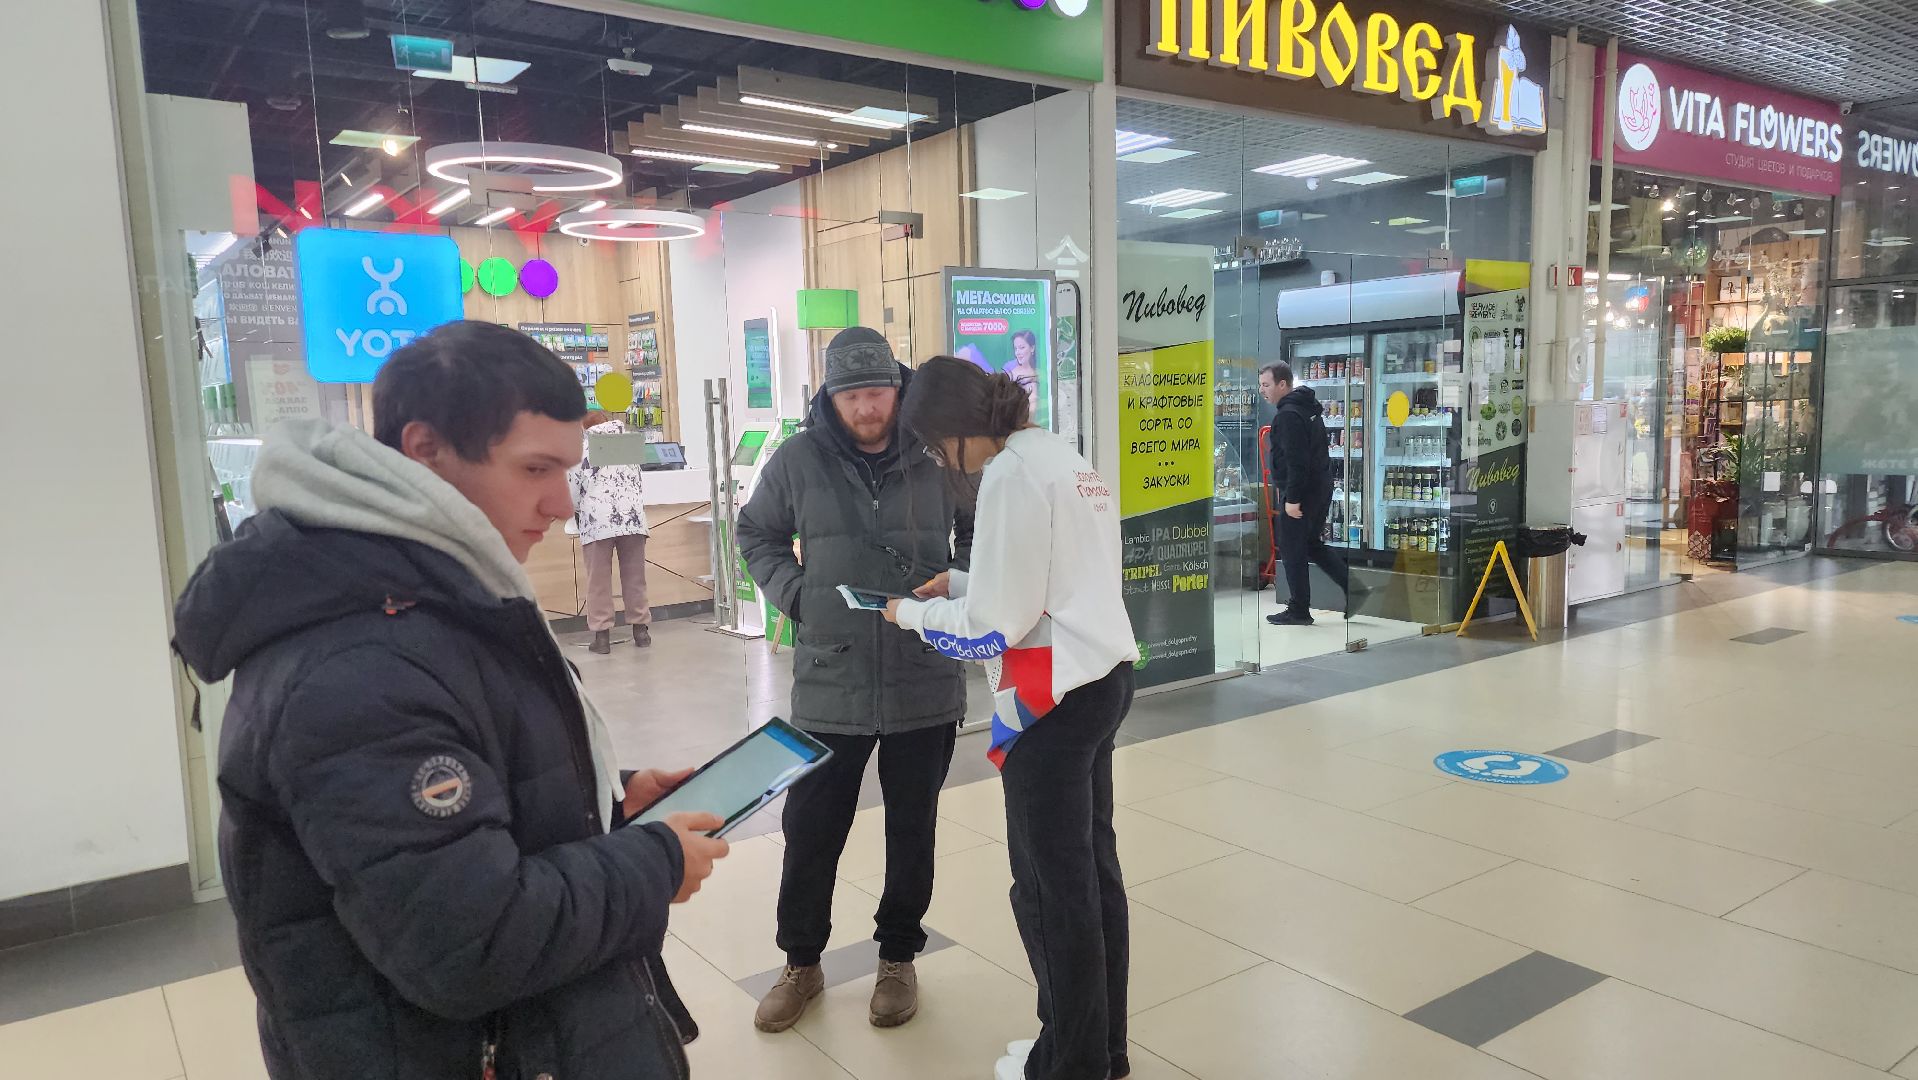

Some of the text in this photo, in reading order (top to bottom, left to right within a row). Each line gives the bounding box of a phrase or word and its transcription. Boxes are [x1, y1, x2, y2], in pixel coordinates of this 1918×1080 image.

[1669, 86, 1843, 163] VITA FLOWERS
[1725, 152, 1833, 183] СТУДИЯ ЦВЕТОВ И ПОДАРКОВ
[335, 328, 431, 358] YOT
[1123, 372, 1207, 387] КЛАССИЧЕСКИЕ
[1127, 397, 1135, 410] И
[1139, 394, 1204, 409] КРАФТОВЫЕ
[1139, 416, 1193, 432] СОРТА СО
[1130, 438, 1201, 455] ВСЕГО МИРА
[1142, 473, 1190, 490] ЗАКУСКИ
[1152, 527, 1171, 543] IPA
[1172, 521, 1209, 540] Dubbel
[1157, 540, 1209, 561] QUADRUPEL
[1123, 563, 1163, 582] TRIPEL
[1182, 559, 1209, 572] Kölsch
[1172, 573, 1209, 593] Porter
